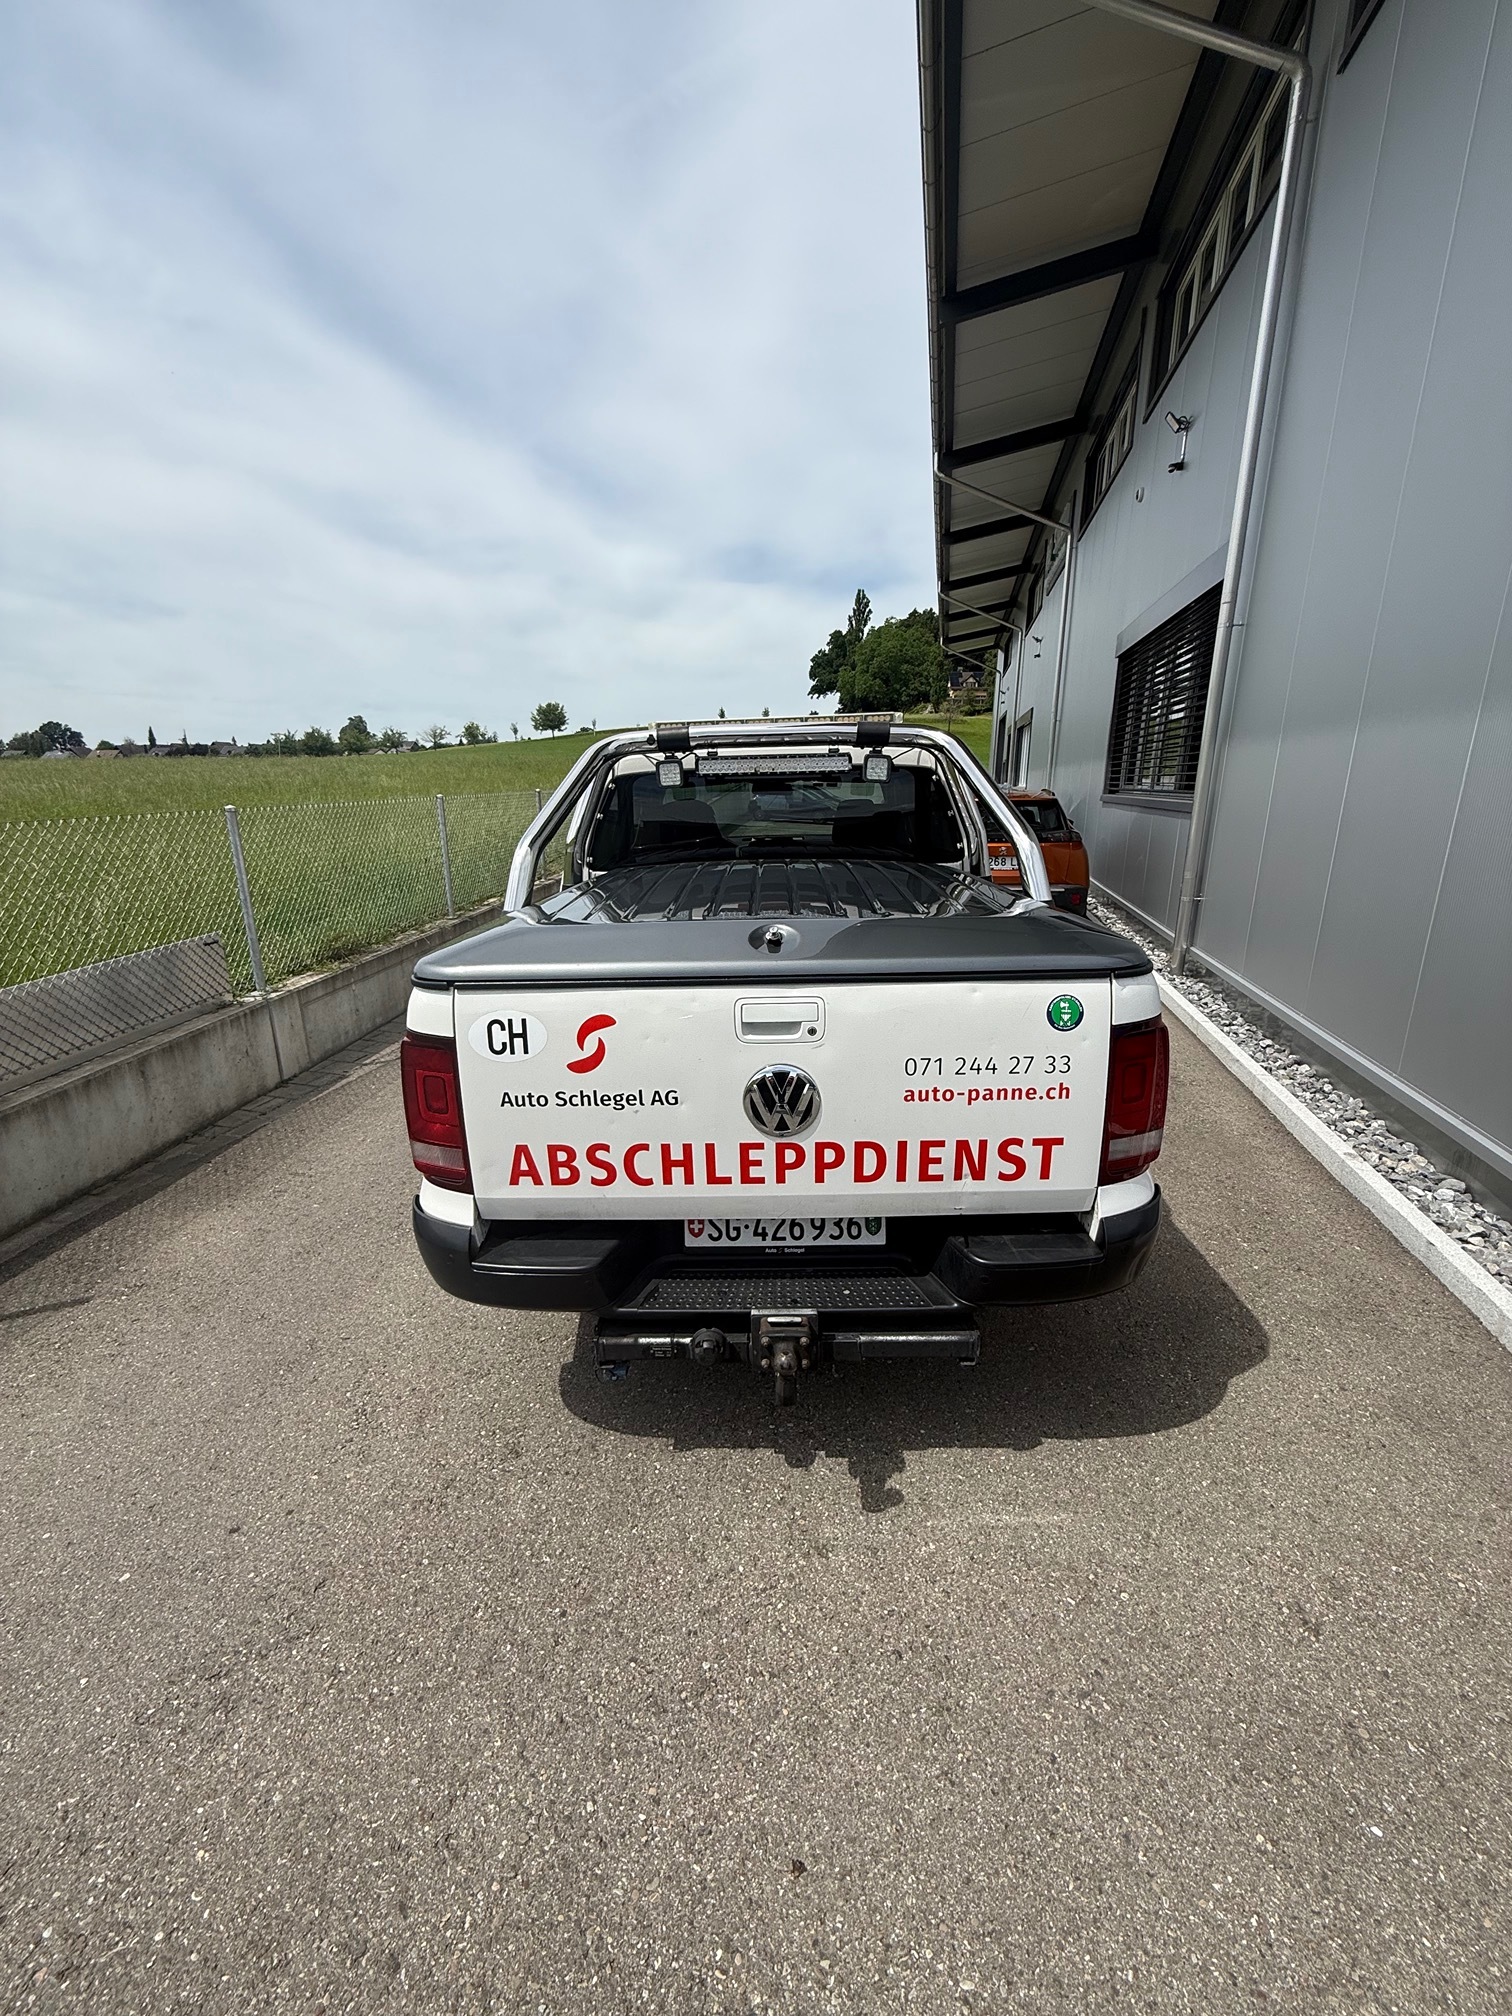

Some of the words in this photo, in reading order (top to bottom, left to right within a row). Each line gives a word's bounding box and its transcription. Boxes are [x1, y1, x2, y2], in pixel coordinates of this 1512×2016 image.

[486, 1018, 529, 1055] CH
[904, 1057, 943, 1076] 071
[954, 1056, 998, 1076] 244
[1008, 1055, 1034, 1075] 27
[1044, 1055, 1071, 1074] 33
[500, 1090, 549, 1108] Auto
[554, 1089, 645, 1111] Schlegel
[650, 1089, 679, 1107] AG
[903, 1082, 1071, 1106] auto-panne.ch
[509, 1137, 1065, 1187] ABSCHLEPPDIENST
